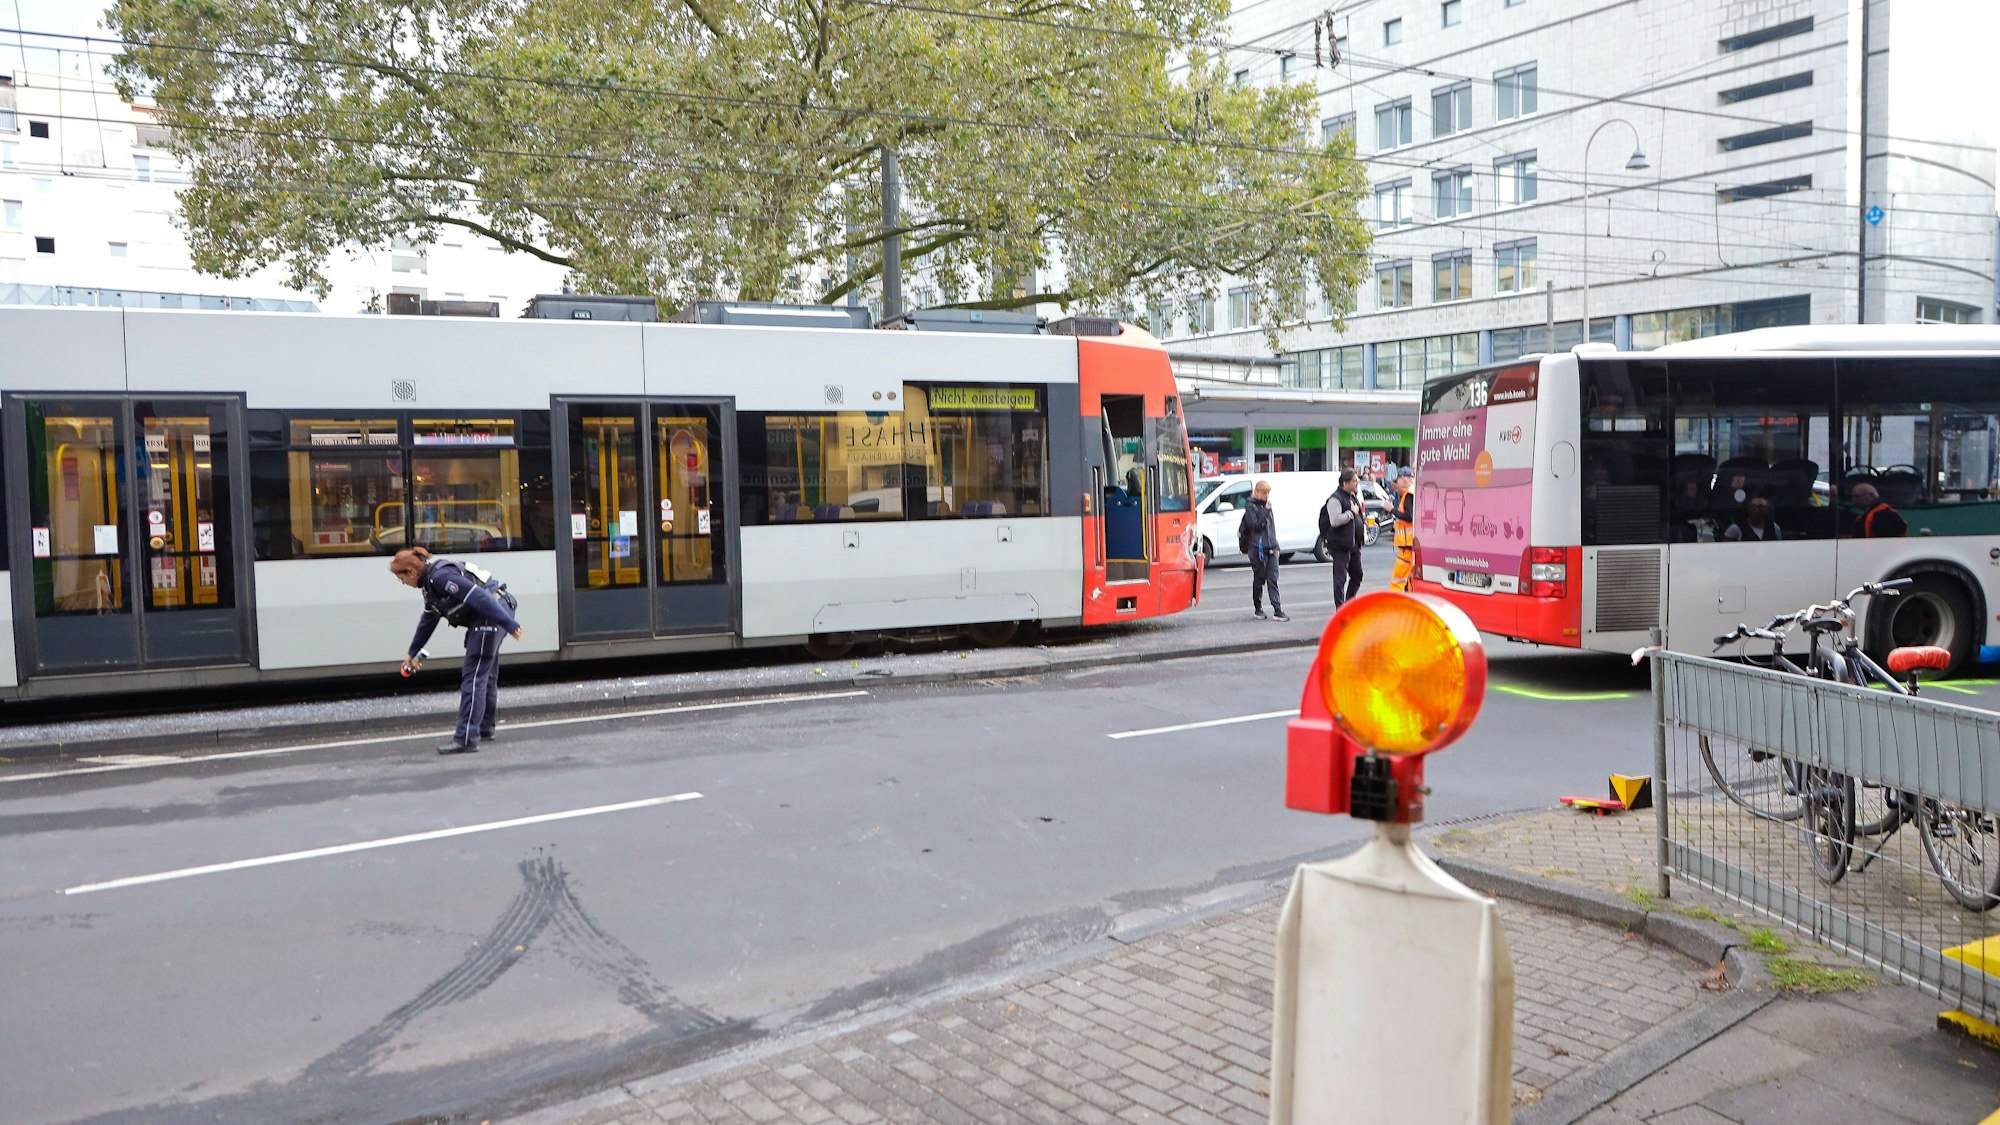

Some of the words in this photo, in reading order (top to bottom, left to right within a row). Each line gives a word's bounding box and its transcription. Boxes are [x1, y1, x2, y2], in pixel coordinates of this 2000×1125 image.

[934, 387, 966, 403] Nicht
[971, 389, 1031, 408] einsteigen
[1469, 381, 1488, 407] 136
[1256, 433, 1293, 445] UMANA
[1351, 432, 1402, 442] SECONDHAND
[1422, 424, 1451, 441] Immer
[1452, 420, 1473, 438] eine
[1420, 446, 1441, 465] gute
[1442, 443, 1471, 461] Wahl!
